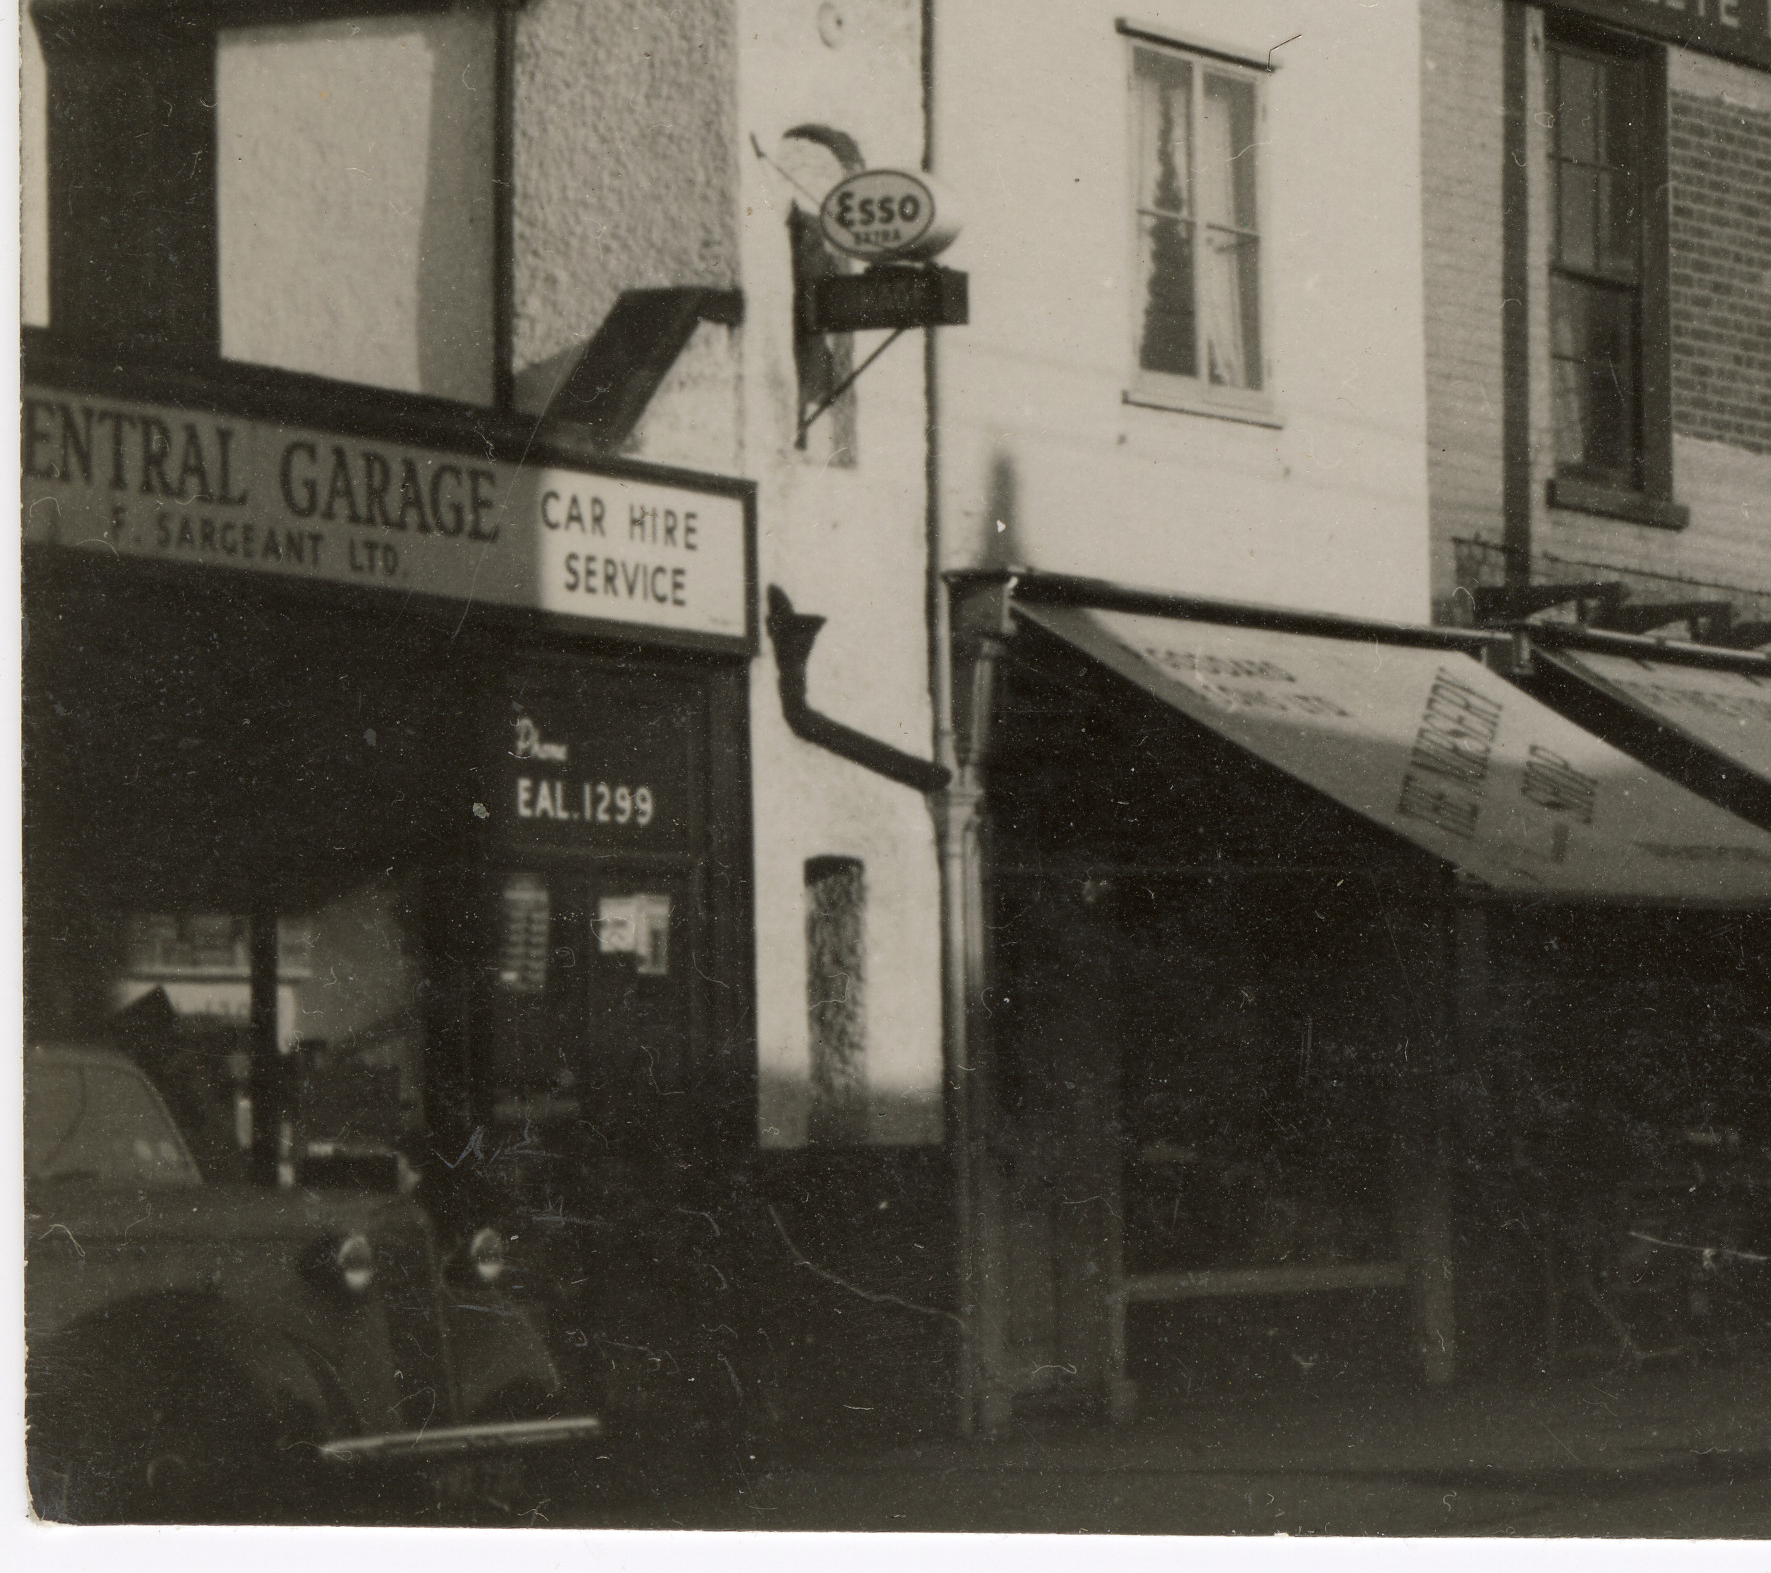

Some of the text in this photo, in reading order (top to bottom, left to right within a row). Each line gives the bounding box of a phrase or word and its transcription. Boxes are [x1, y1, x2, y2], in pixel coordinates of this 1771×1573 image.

[279, 441, 502, 544] GARAGE
[540, 489, 699, 551] CAR HIRE
[110, 505, 410, 580] F. SARGEANT LTD.
[564, 552, 687, 607] SERVICE
[1396, 666, 1503, 839] THE NURSERY
[1520, 744, 1599, 825] SHOP
